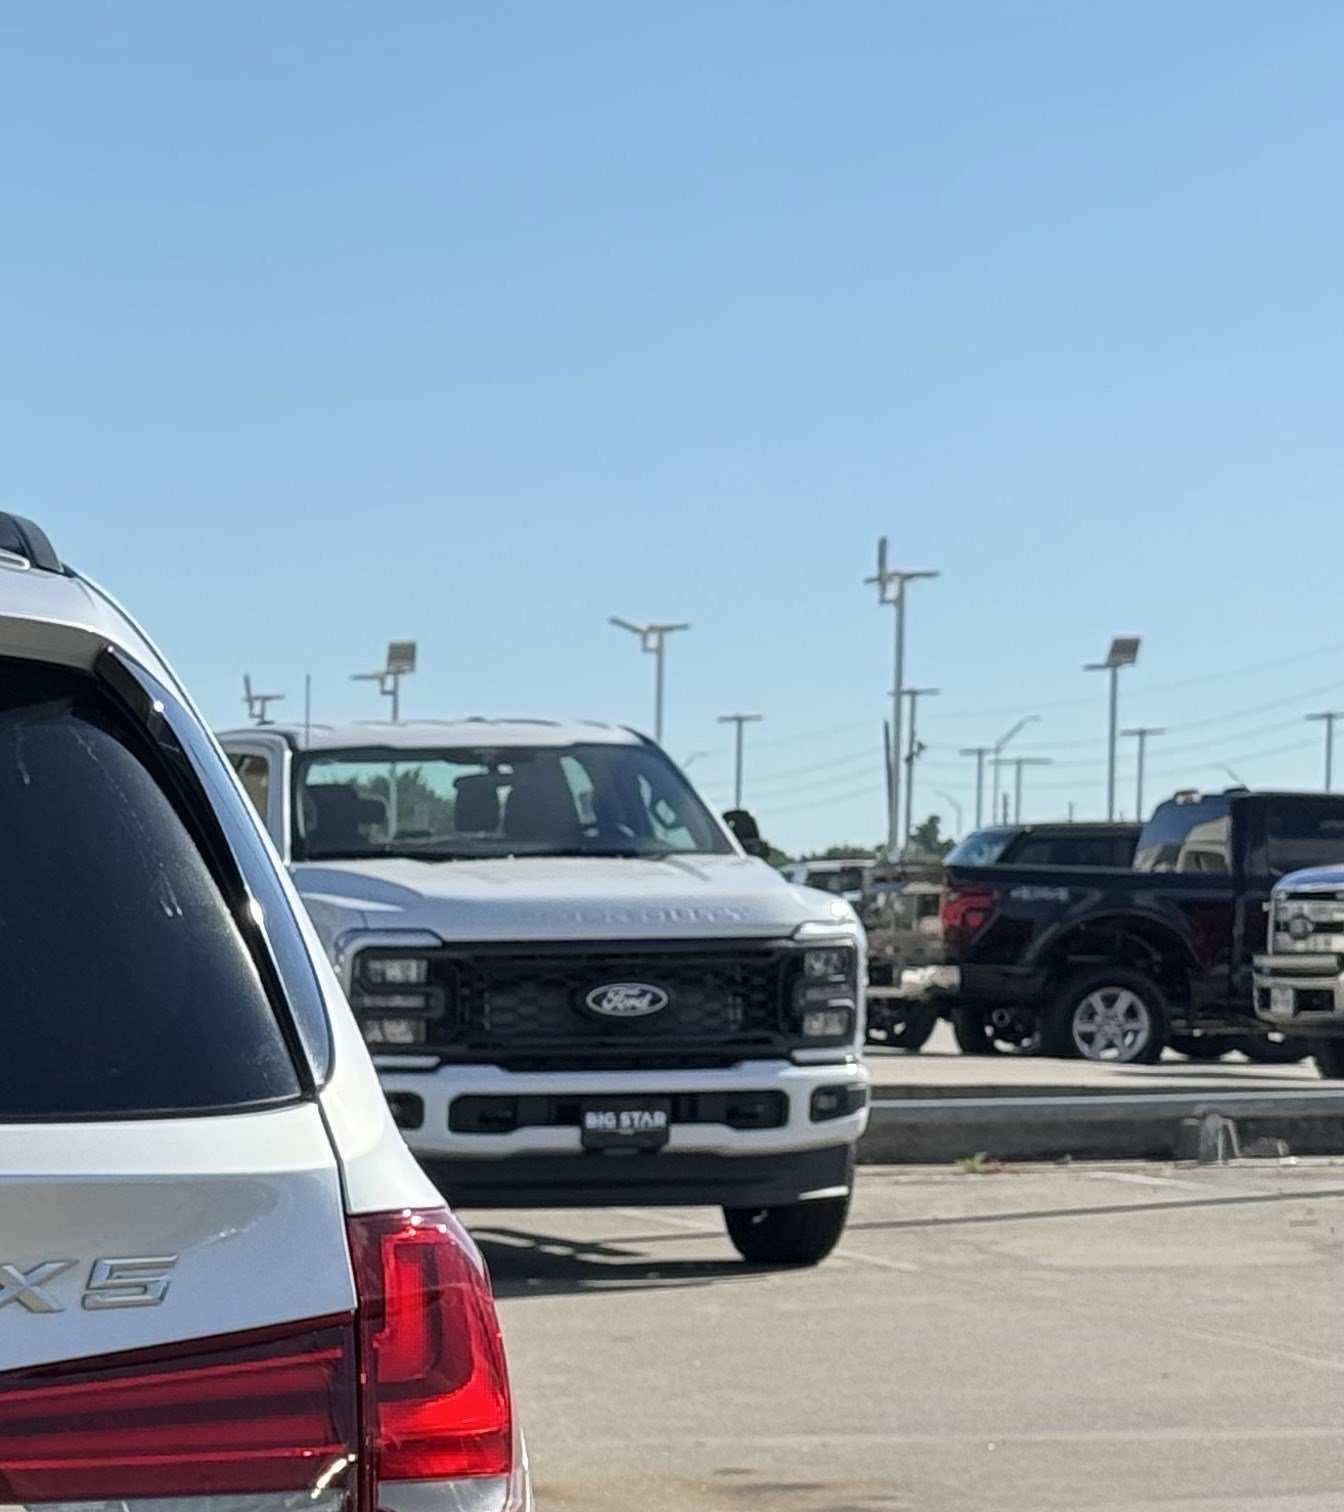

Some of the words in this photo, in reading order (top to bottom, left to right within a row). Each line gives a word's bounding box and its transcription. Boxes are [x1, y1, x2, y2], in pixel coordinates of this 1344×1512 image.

[601, 986, 653, 1011] Ford
[585, 1111, 617, 1129] BIG
[619, 1110, 667, 1129] STAR
